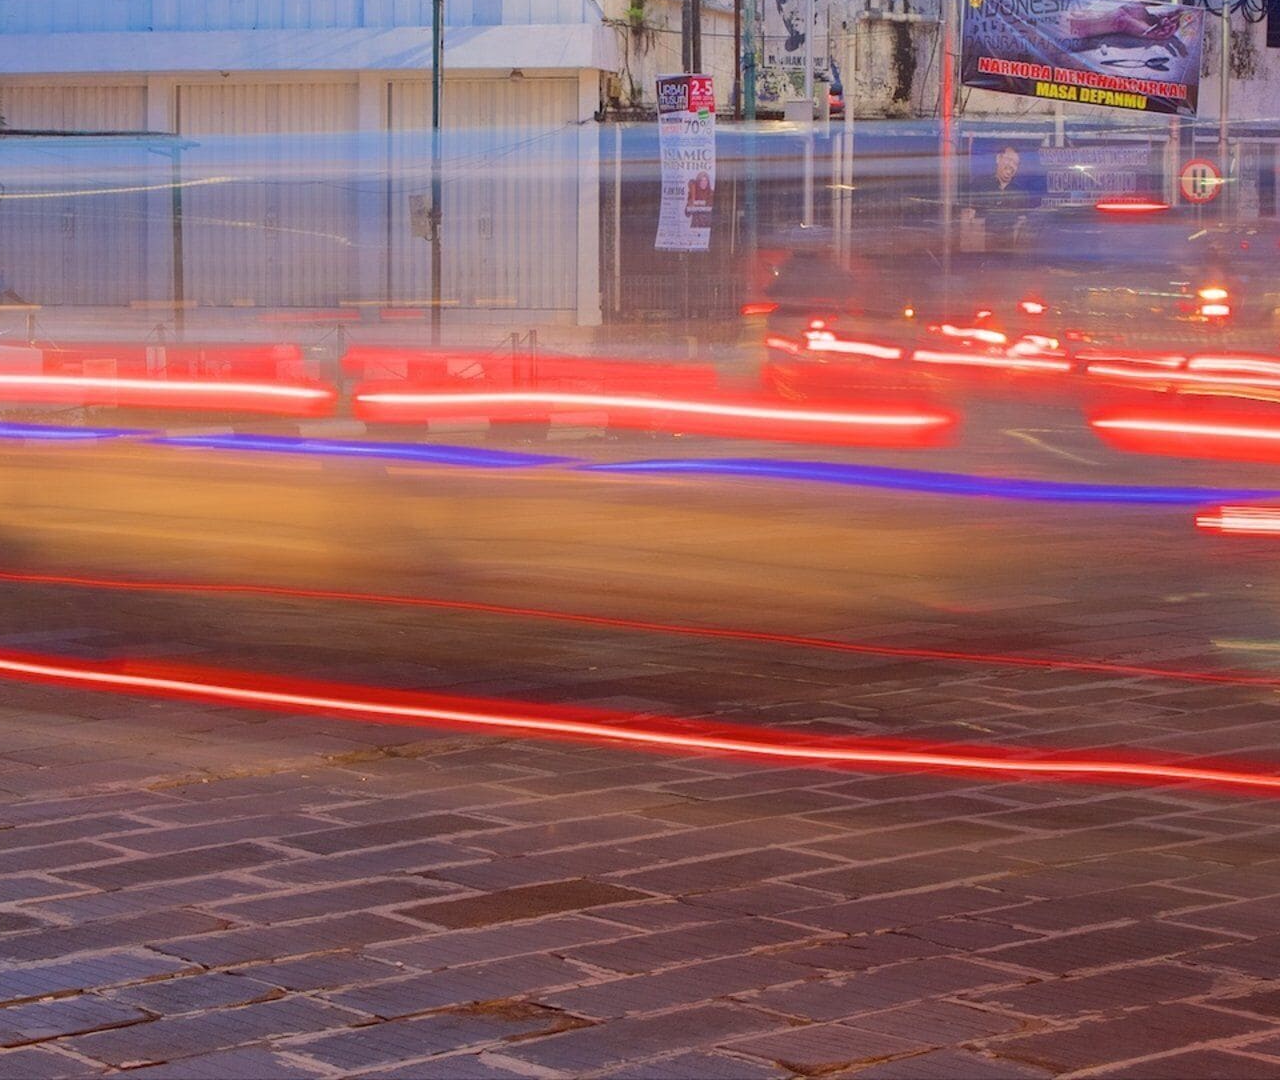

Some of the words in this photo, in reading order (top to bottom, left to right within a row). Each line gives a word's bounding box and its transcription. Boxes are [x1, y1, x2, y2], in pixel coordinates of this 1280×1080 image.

[978, 56, 1052, 81] NARKOBA
[691, 80, 713, 96] 2-5
[1036, 81, 1078, 100] MASA
[1079, 86, 1148, 109] DEPANMU
[683, 120, 713, 136] 70%
